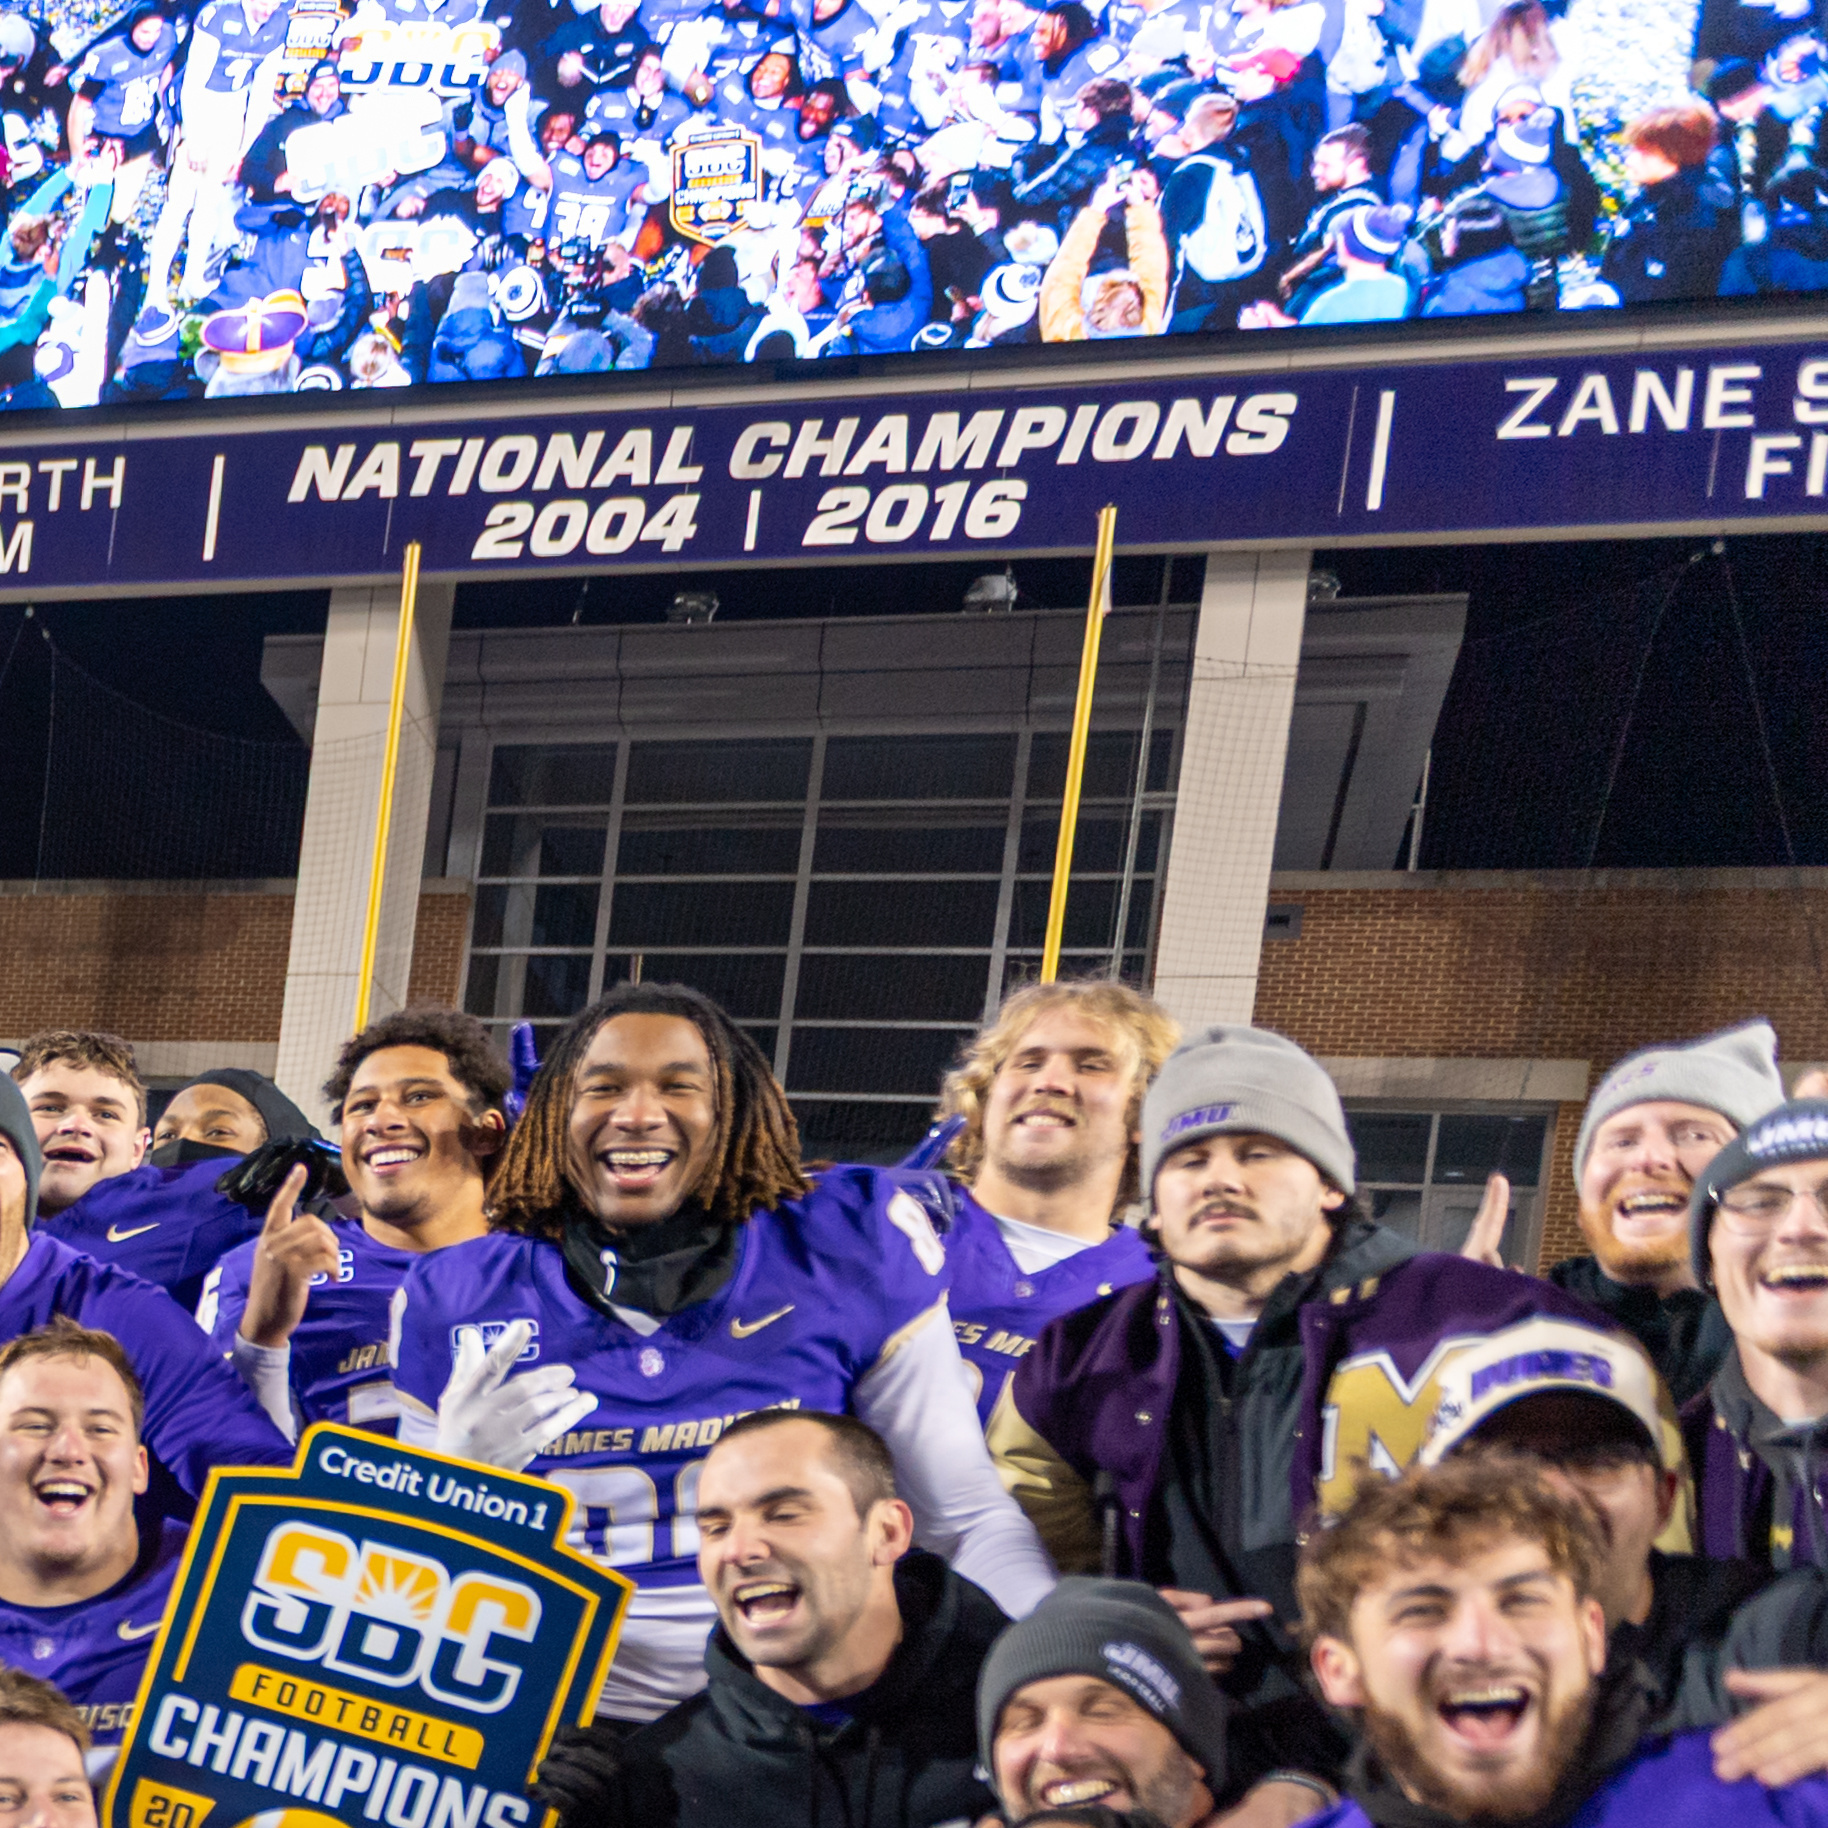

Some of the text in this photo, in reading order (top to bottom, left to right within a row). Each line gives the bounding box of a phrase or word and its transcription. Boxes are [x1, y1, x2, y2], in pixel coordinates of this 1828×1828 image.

[1497, 363, 1762, 440] ZANE
[288, 393, 1298, 502] NATIONAL CHAMPIONS
[471, 480, 1028, 560] 2004 2016
[1159, 1102, 1236, 1142] JMU
[543, 1427, 635, 1456] AMES
[318, 1445, 548, 1532] Credit Union 1
[241, 1520, 544, 1714] SBC
[250, 1673, 460, 1759] FOOTBALL
